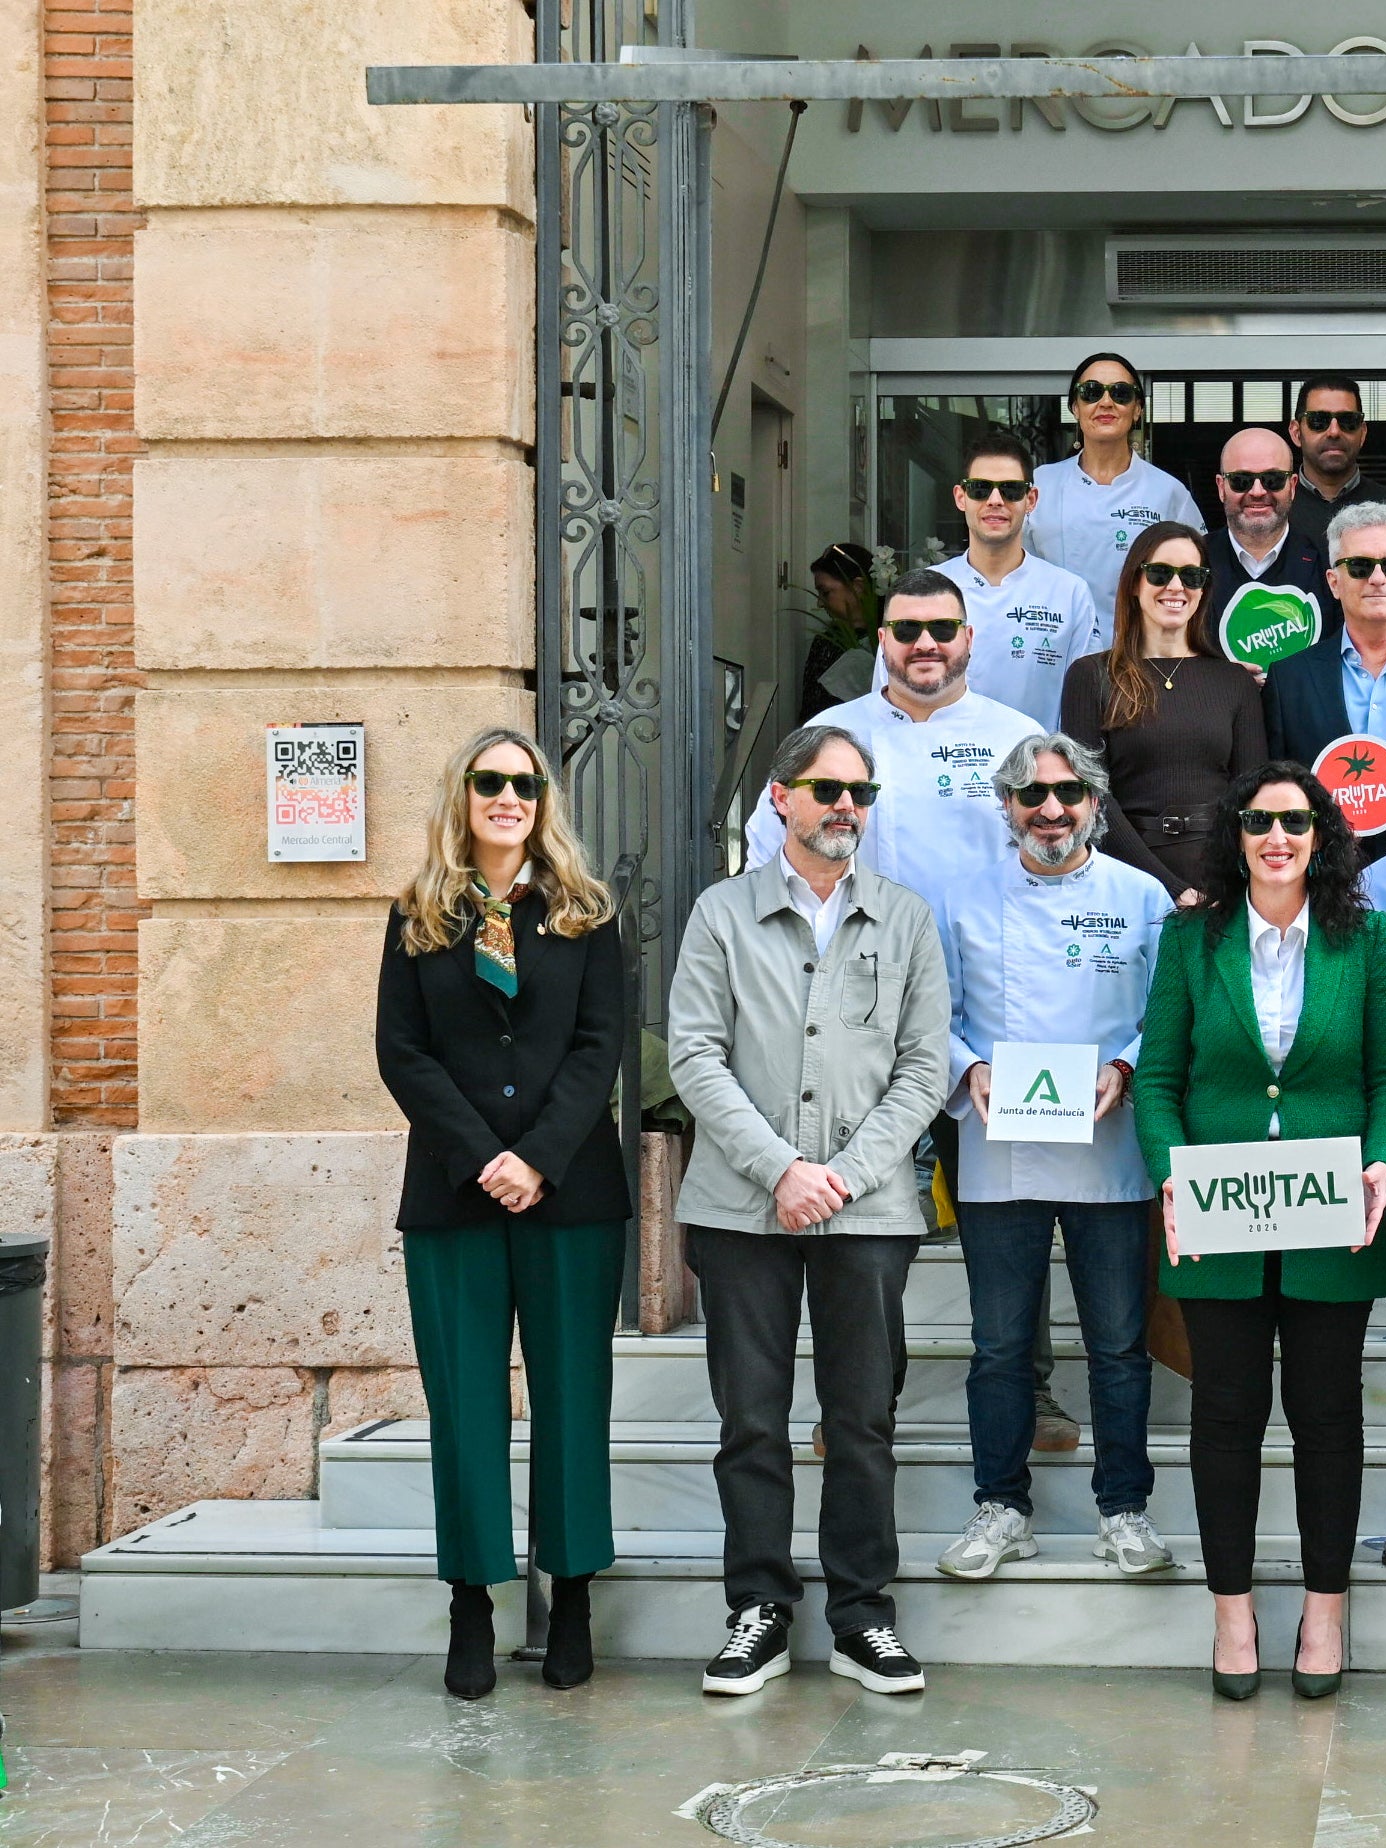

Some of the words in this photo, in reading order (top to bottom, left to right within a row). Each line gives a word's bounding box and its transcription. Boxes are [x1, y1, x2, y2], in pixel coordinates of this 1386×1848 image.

[281, 835, 320, 845] Mercado
[321, 834, 353, 845] Central
[997, 1107, 1024, 1115] Junta
[1026, 1107, 1038, 1115] de
[1039, 1107, 1085, 1117] Andalucía
[1188, 1170, 1348, 1219] VRUTAL
[1248, 1223, 1278, 1233] 2026
